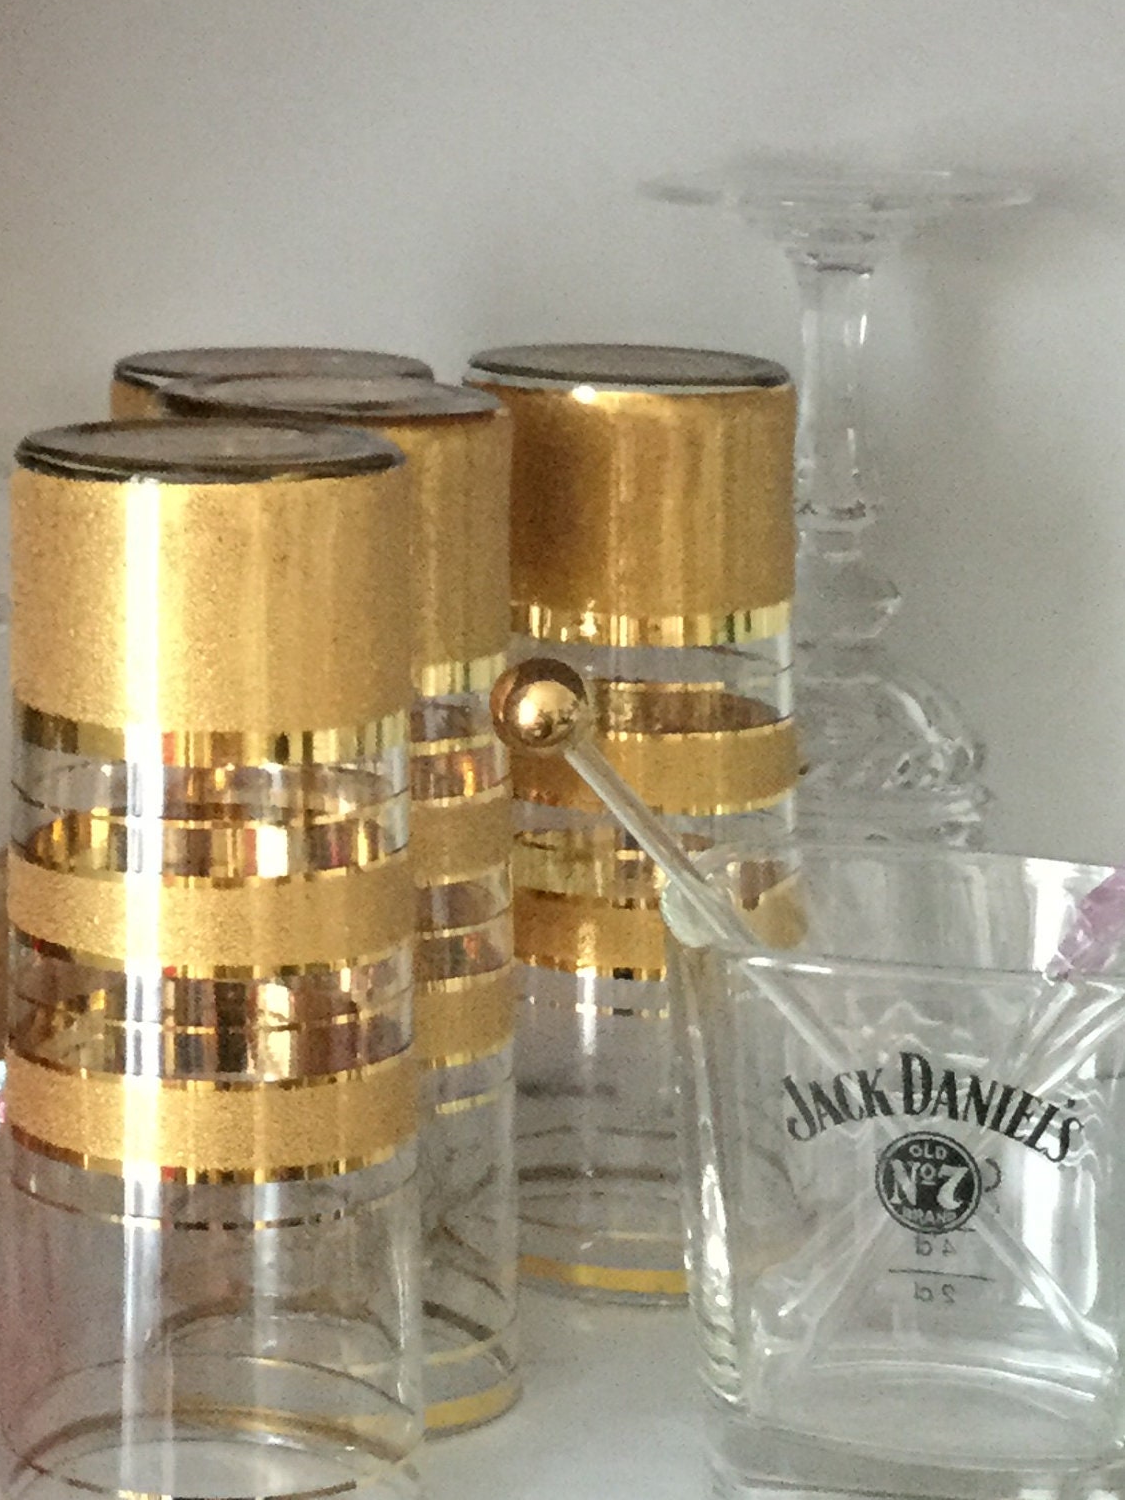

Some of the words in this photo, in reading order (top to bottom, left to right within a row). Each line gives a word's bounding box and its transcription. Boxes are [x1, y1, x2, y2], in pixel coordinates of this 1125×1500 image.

[781, 1067, 893, 1142] JACK
[899, 1051, 1085, 1163] DANIEL'S
[908, 1143, 947, 1160] OLD
